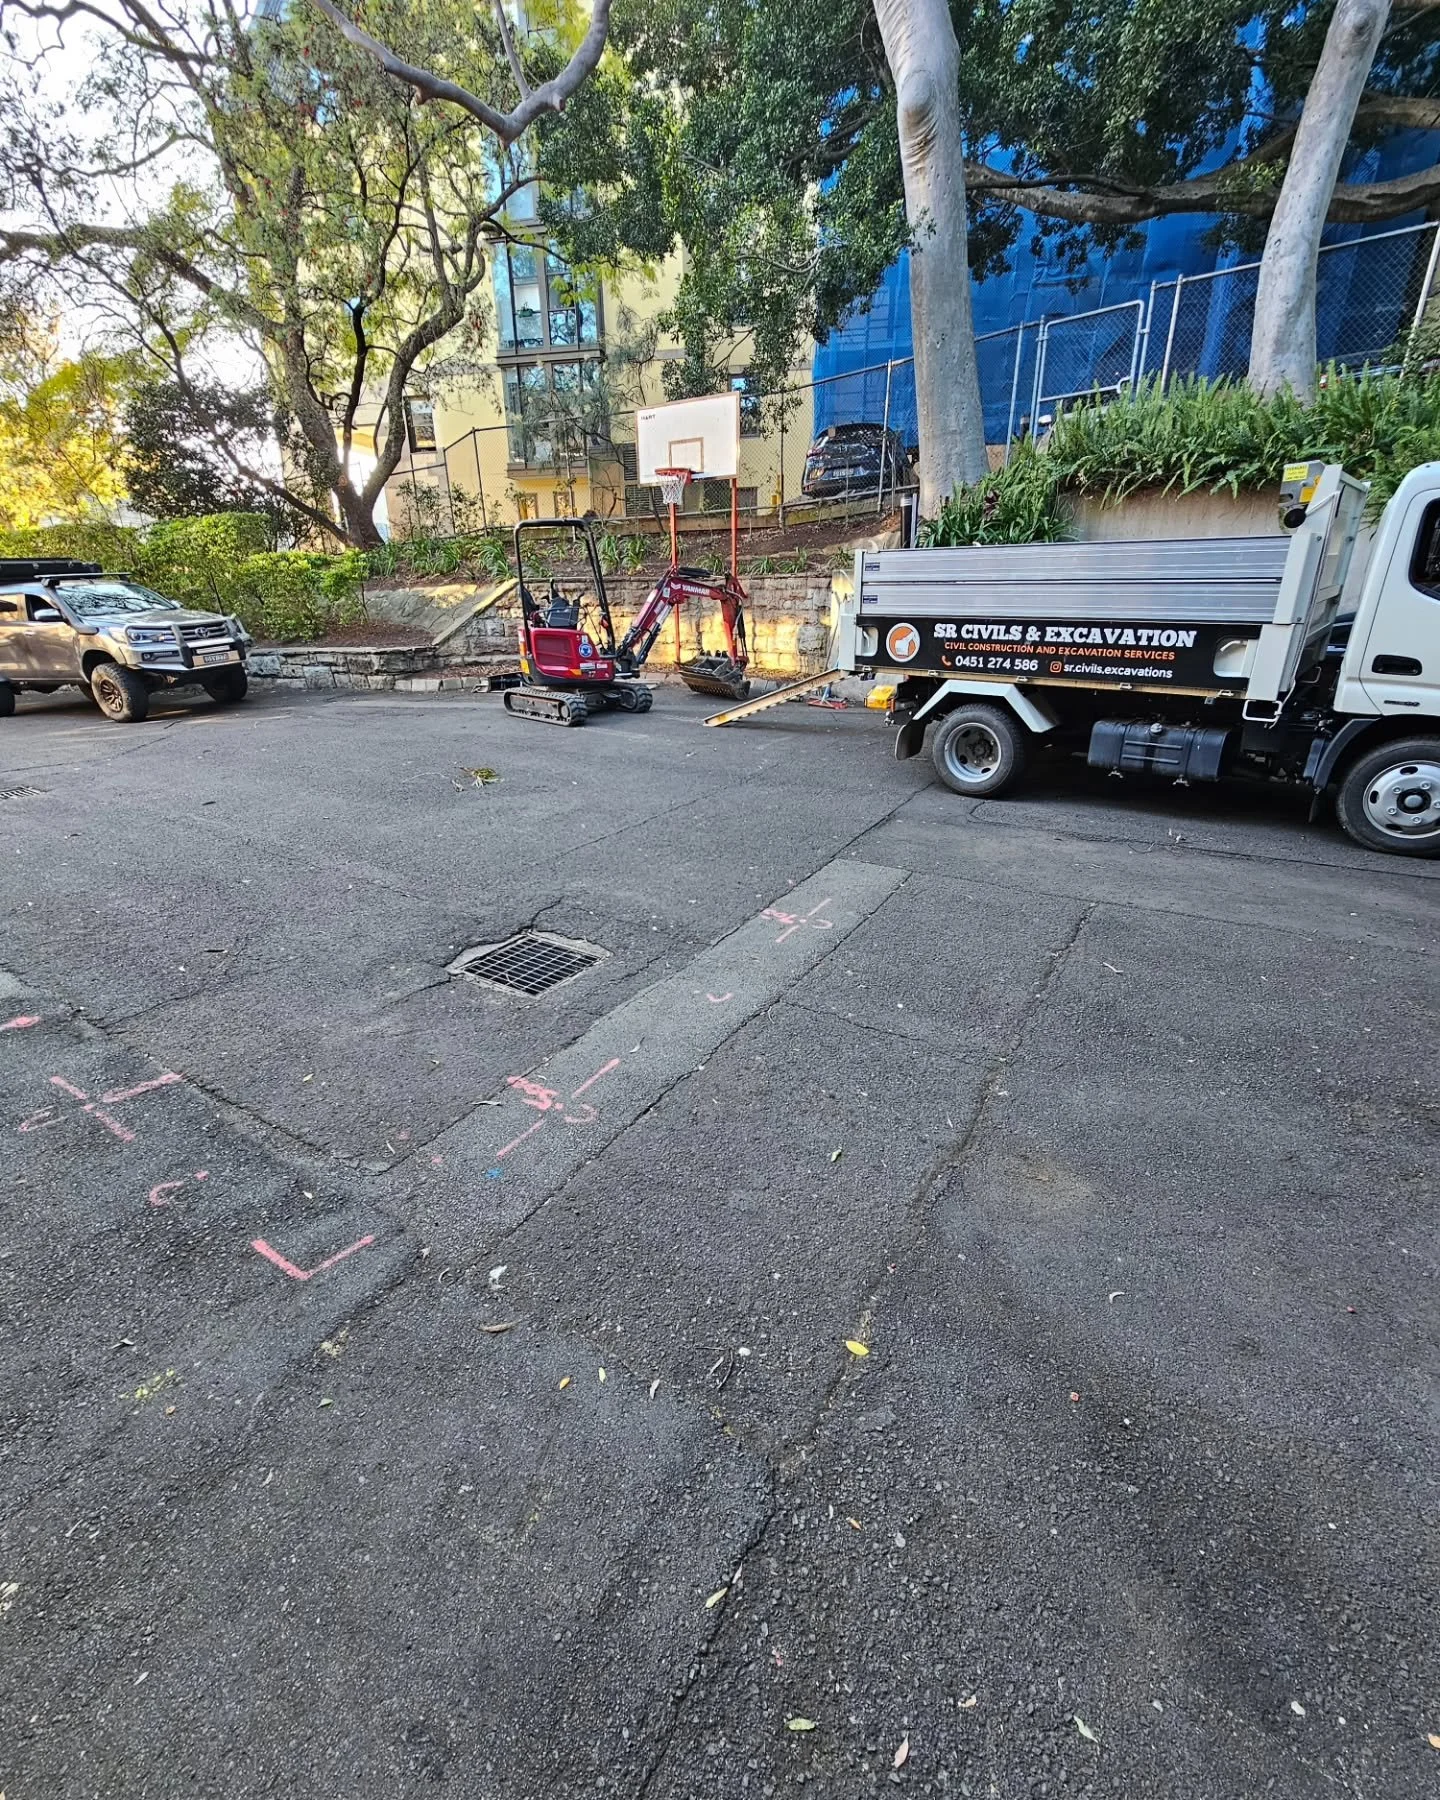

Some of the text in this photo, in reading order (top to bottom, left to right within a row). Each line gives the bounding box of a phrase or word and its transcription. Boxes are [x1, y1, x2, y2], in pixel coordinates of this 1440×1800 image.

[682, 584, 710, 596] YANMAR
[934, 623, 1197, 647] SR CIVILS & EXCAVATION
[944, 642, 1175, 660] CIVIL CONSTRUCTION AND EXCAVATION SERVICES
[955, 656, 1039, 671] 0451 274 586
[1063, 662, 1173, 679] sr.civils.excavations
